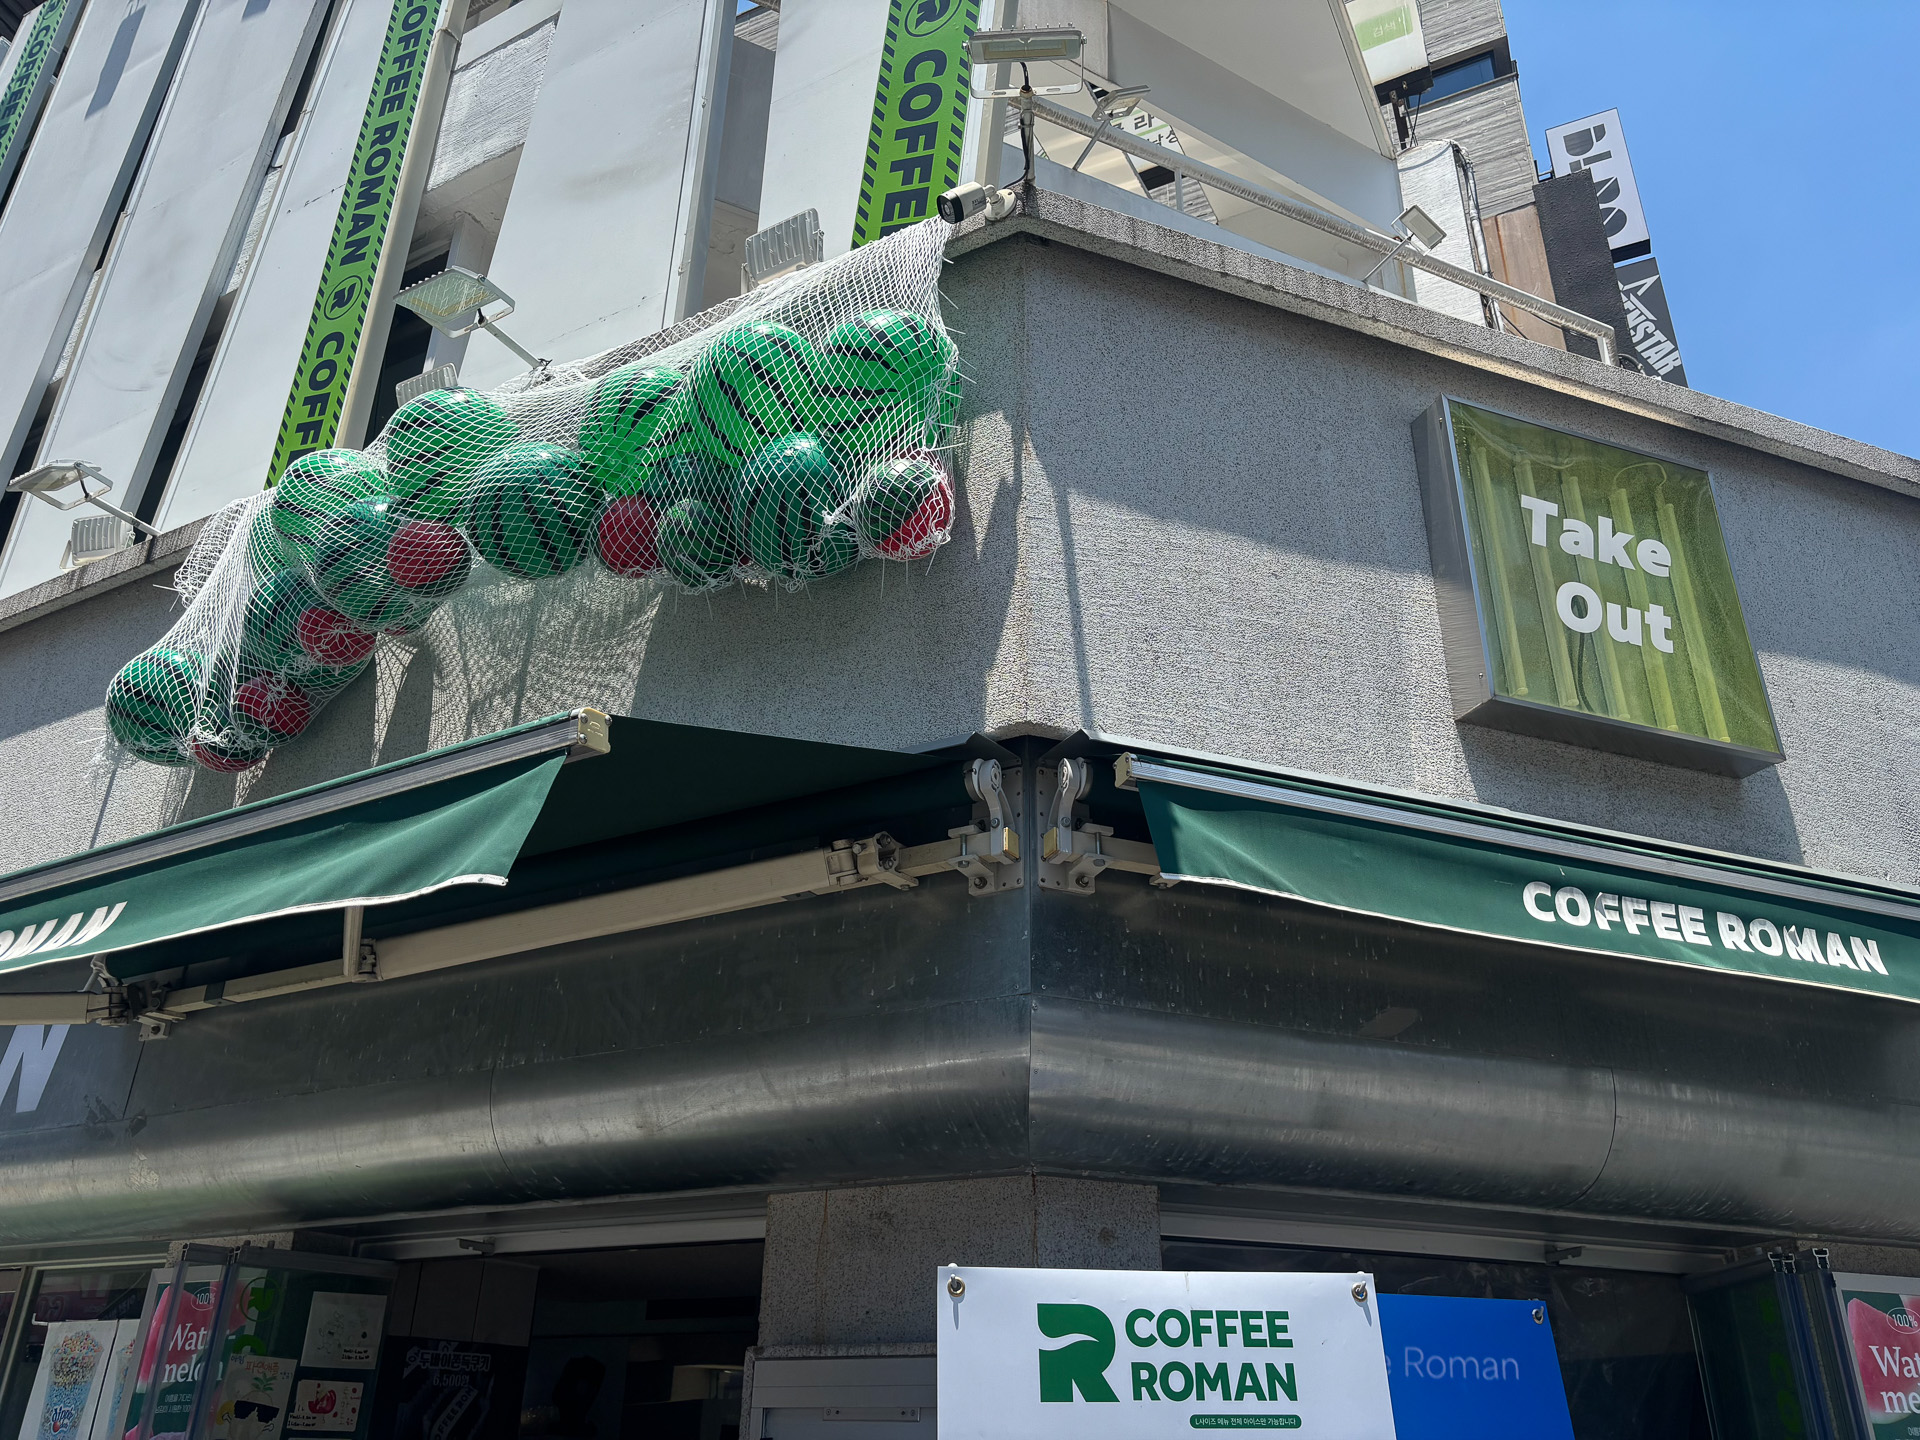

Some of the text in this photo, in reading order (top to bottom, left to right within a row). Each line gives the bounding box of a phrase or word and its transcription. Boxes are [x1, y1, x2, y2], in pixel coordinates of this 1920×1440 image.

[340, 120, 400, 267] ROMAN
[1520, 494, 1672, 578] Take
[1556, 581, 1674, 654] Out
[1522, 881, 1890, 976] COFFEE ROMAN
[1125, 1308, 1294, 1349] COFFEE
[1131, 1361, 1299, 1403] ROMAN
[1404, 1346, 1520, 1380] Roman
[1230, 1417, 1243, 1426] 전체
[1243, 1417, 1267, 1426] 아이스만
[1268, 1417, 1296, 1426] 가능합니다
